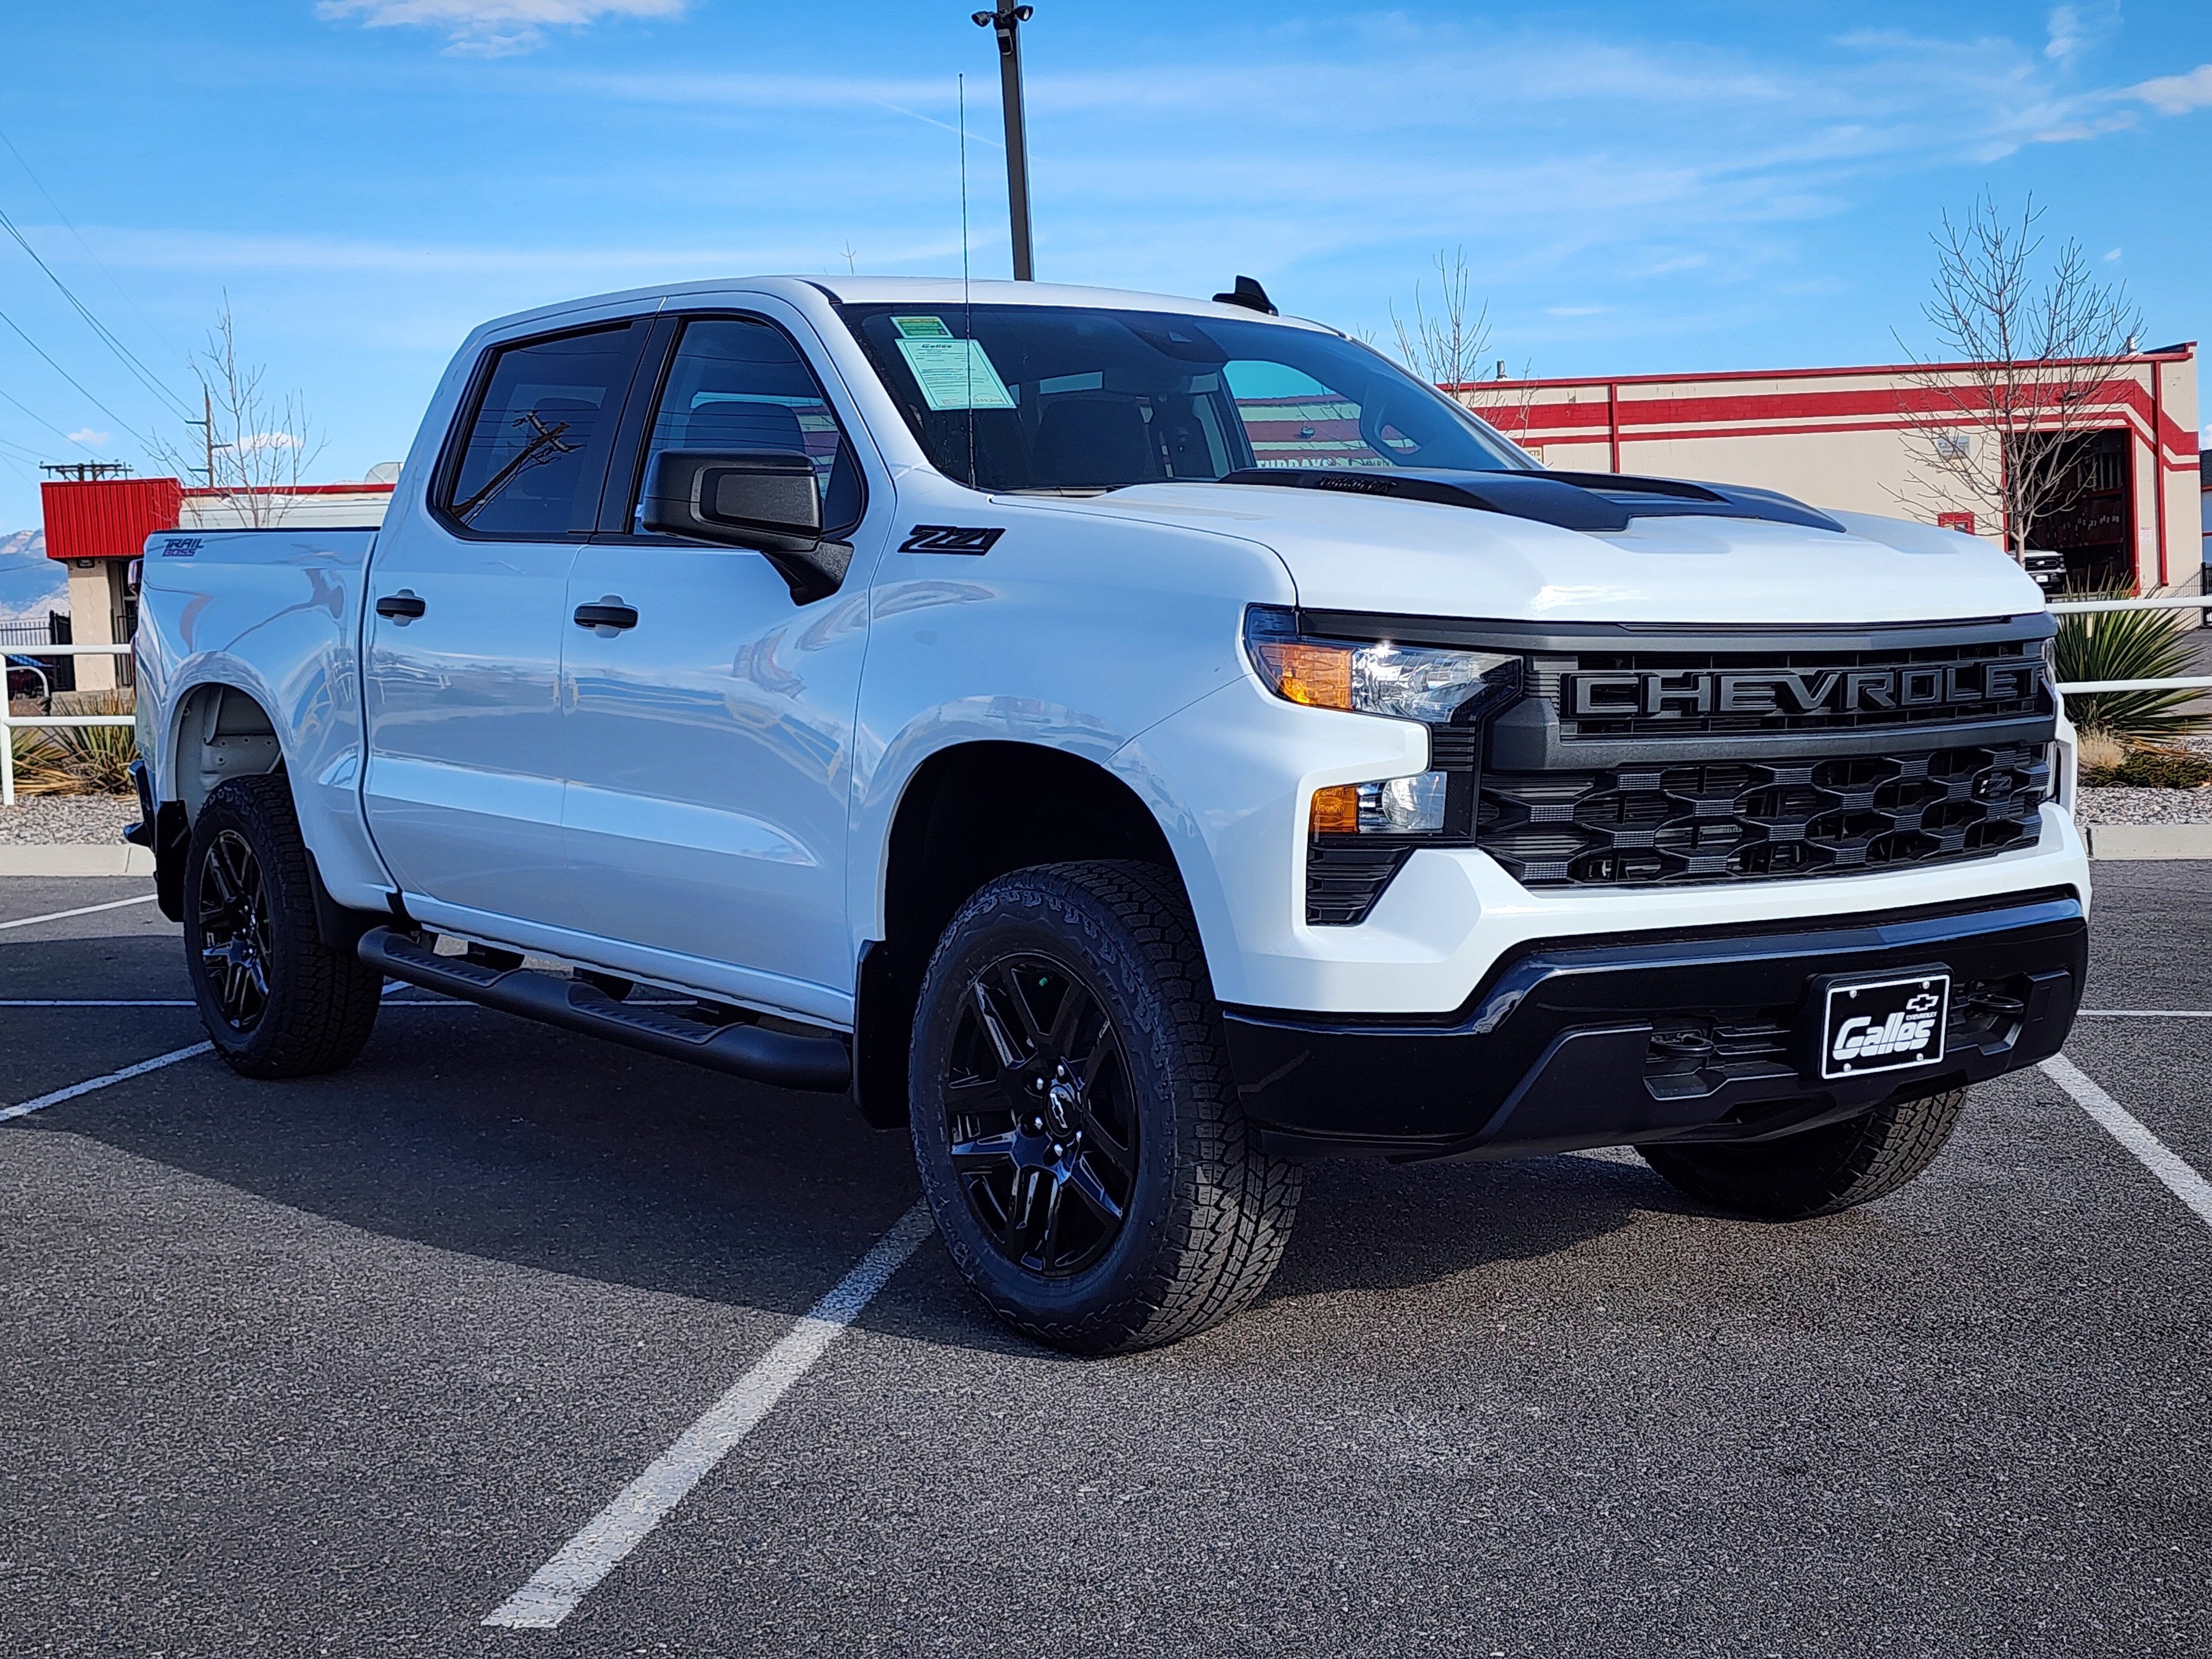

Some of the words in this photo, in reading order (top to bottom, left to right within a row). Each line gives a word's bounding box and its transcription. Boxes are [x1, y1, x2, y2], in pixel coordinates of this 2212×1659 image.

[164, 538, 205, 549] TRAIL
[897, 524, 1006, 556] Z71
[162, 548, 197, 557] BOSS
[1572, 660, 2048, 716] CHEVROLET
